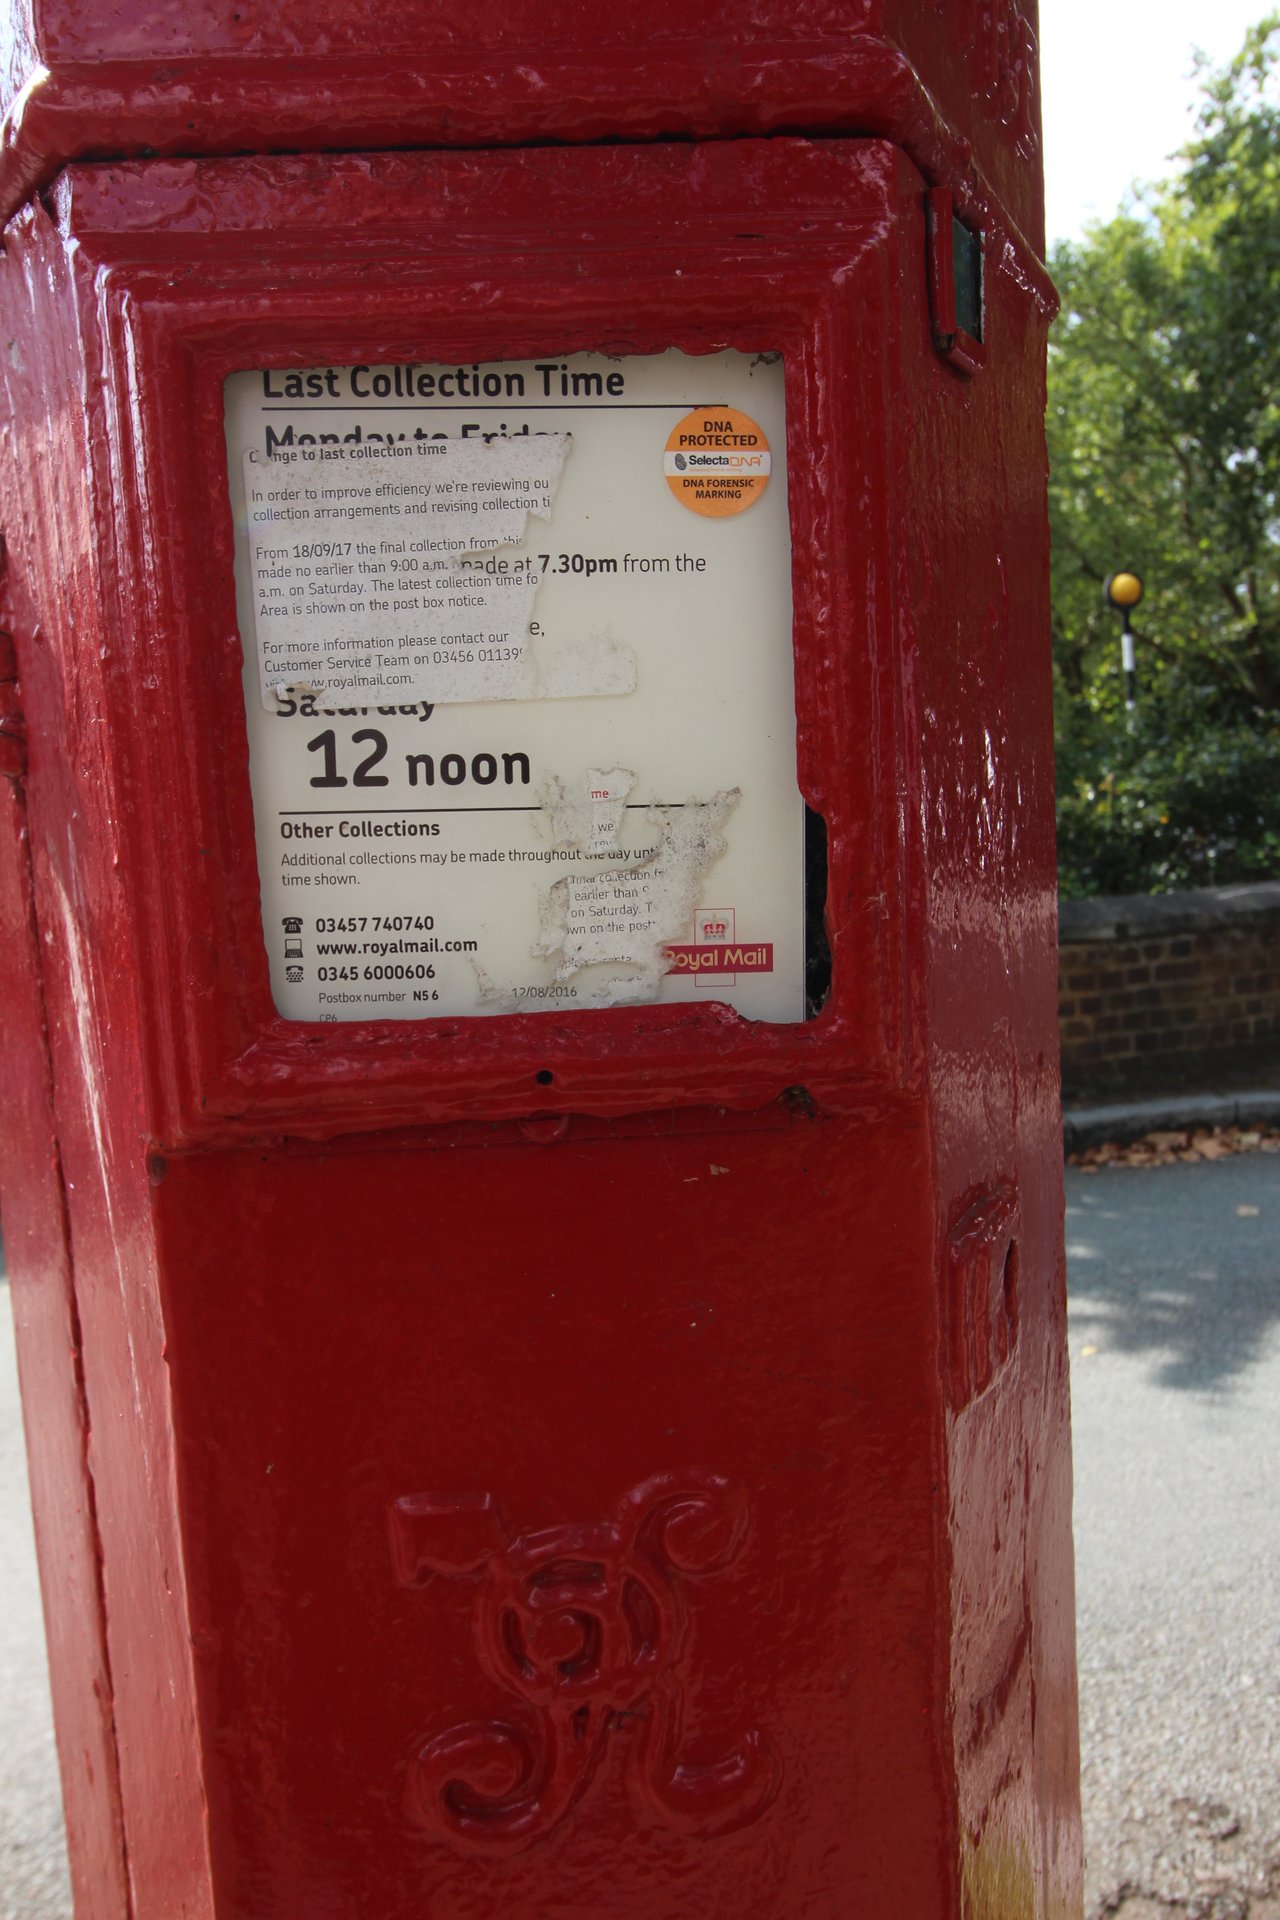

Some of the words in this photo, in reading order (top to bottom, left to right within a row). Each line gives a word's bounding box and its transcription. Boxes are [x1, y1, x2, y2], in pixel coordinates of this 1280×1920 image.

[263, 370, 341, 398] Last
[350, 365, 525, 398] Collection
[535, 365, 624, 397] Time
[704, 421, 733, 432] DNA
[680, 435, 758, 446] PROTECTED
[249, 450, 297, 464] Cnge
[302, 450, 315, 461] to
[320, 448, 345, 460] last
[350, 446, 412, 459] collection
[417, 443, 447, 455] time
[252, 490, 262, 501] In
[268, 488, 300, 501] order
[305, 488, 317, 499] to
[321, 487, 371, 500] improve
[375, 483, 431, 497] efficiency
[435, 480, 468, 493] we're
[472, 478, 529, 492] reviewing
[683, 479, 704, 488] DNA
[706, 479, 755, 488] FORENSIC
[695, 490, 742, 499] MARKING
[253, 508, 310, 521] collection
[314, 504, 400, 519] arrangements
[405, 501, 427, 514] and
[432, 500, 478, 513] revising
[482, 497, 538, 511] collection
[256, 547, 288, 560] From
[293, 543, 352, 558] 18/09/17
[356, 542, 376, 555] the
[381, 540, 405, 554] final
[410, 538, 465, 551] collection
[470, 537, 499, 550] from
[258, 566, 291, 579] made
[296, 567, 311, 577] no
[315, 562, 354, 576] earlier
[358, 560, 386, 574] than
[390, 558, 418, 572] 9:00
[422, 559, 449, 571] a.m.
[514, 556, 532, 573] at
[537, 553, 617, 577] 7.30pm
[623, 553, 669, 572] from
[675, 552, 706, 572] the
[259, 587, 285, 598] a.m.
[289, 586, 304, 596] on
[308, 581, 367, 595] Saturday.
[370, 579, 394, 592] The
[398, 578, 432, 590] latest
[436, 576, 491, 589] collection
[260, 604, 288, 616] Area
[293, 602, 302, 615] is
[307, 602, 345, 614] shown
[349, 602, 365, 611] on
[370, 599, 389, 610] the
[393, 597, 419, 612] post
[423, 596, 444, 608] box
[448, 594, 487, 607] notice.
[263, 642, 283, 654] For
[288, 642, 319, 652] more
[323, 636, 394, 651] information
[398, 634, 437, 649] please
[441, 632, 484, 645] contact
[488, 632, 509, 643] our
[264, 660, 323, 672] Customer
[327, 657, 371, 670] Service
[375, 654, 409, 667] Team
[414, 655, 429, 665] on
[433, 650, 474, 663] 03456
[307, 728, 389, 788] 12
[405, 752, 530, 786] noon
[280, 822, 333, 839] Other
[339, 820, 440, 838] Collections
[281, 852, 346, 866] Additional
[349, 851, 416, 865] collections
[420, 853, 447, 866] may
[450, 850, 466, 863] be
[470, 849, 505, 862] made
[509, 848, 581, 864] throughout
[282, 873, 311, 886] time
[314, 873, 360, 885] shown.
[574, 886, 609, 901] earlier
[614, 885, 638, 898] than
[571, 909, 584, 918] on
[315, 917, 367, 933] 03457
[372, 916, 434, 931] 740740
[590, 924, 603, 933] on
[316, 938, 478, 956] www.royalmail.com
[723, 948, 767, 966] Mail
[318, 966, 359, 981] 0345
[364, 964, 436, 980] 6000606
[318, 992, 361, 1003] Postbox
[364, 992, 406, 1002] number
[413, 990, 429, 1001] N5
[432, 990, 439, 1001] 6
[512, 986, 577, 998] 12/08/2016
